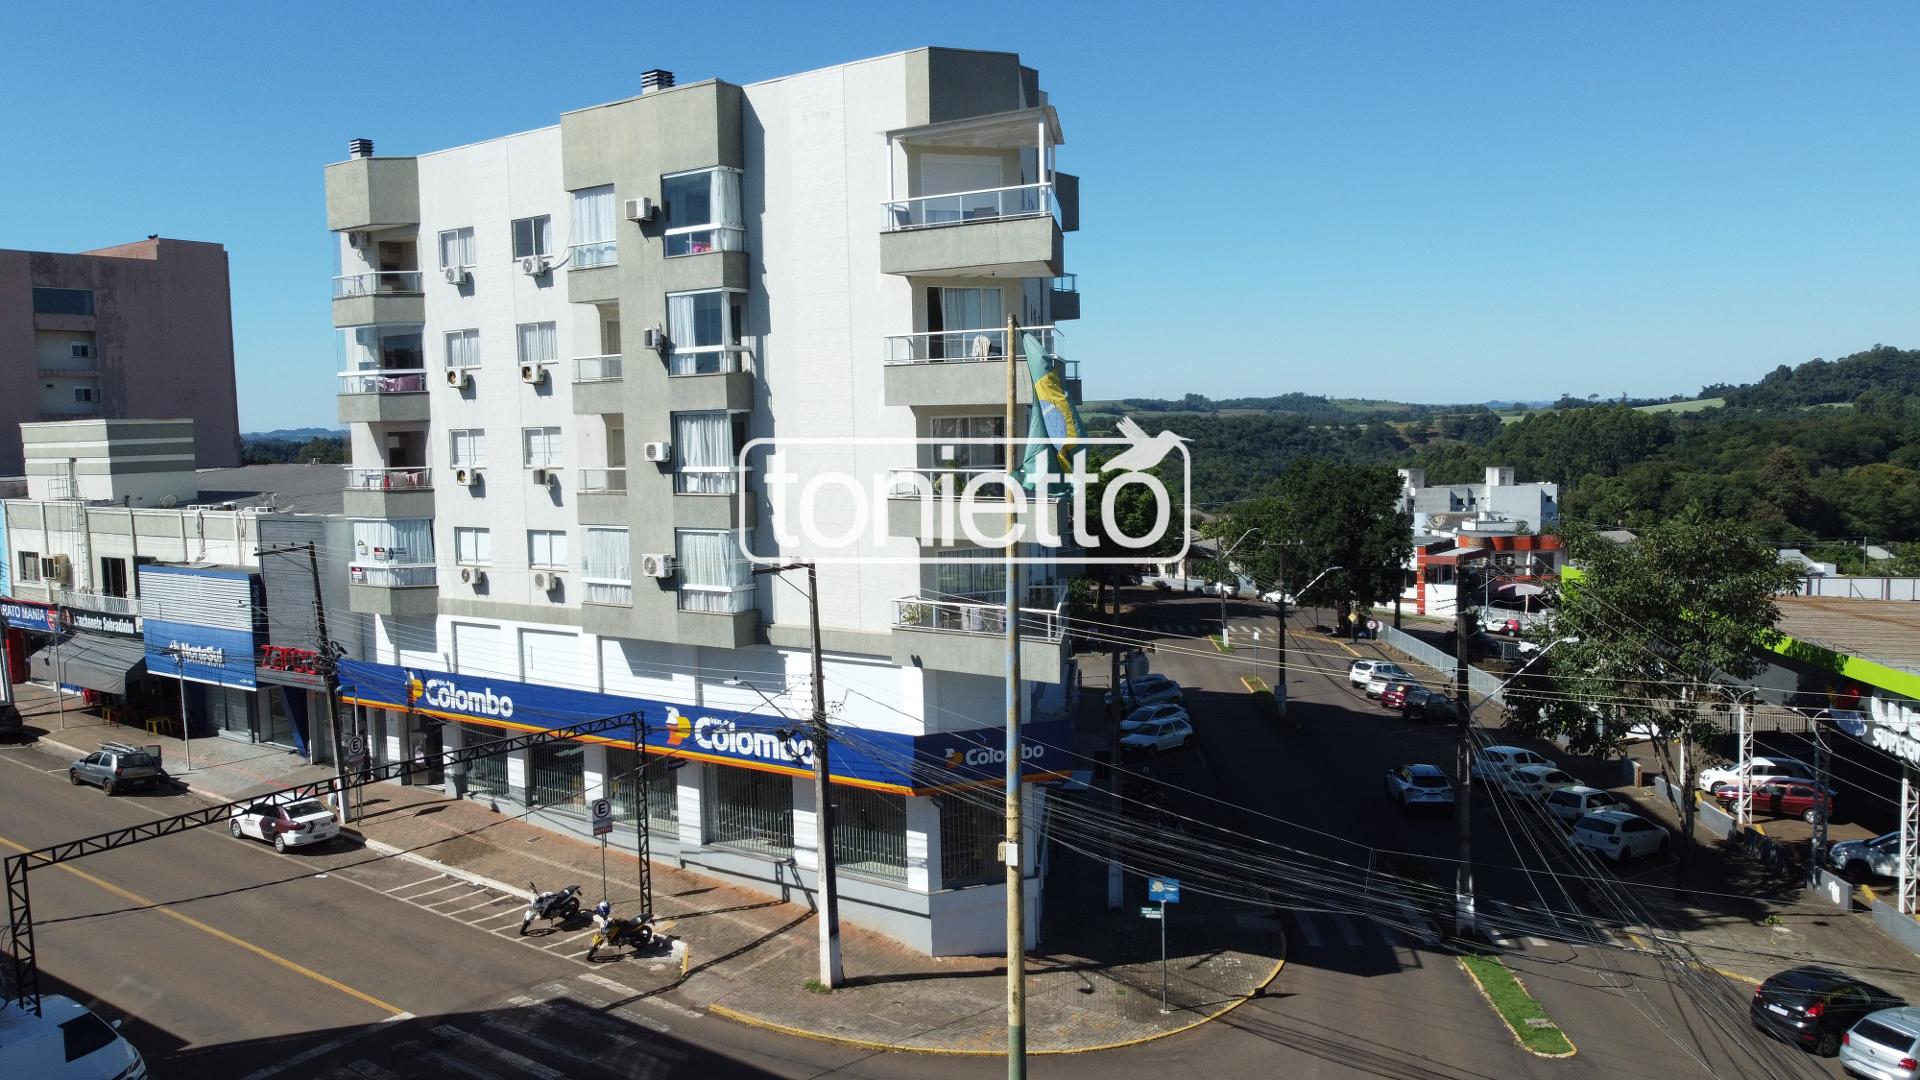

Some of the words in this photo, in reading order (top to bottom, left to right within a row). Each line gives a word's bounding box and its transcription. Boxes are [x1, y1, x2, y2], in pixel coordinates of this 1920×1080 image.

[0, 604, 21, 618] RATO
[22, 607, 46, 622] MANIA
[426, 679, 514, 717] Colombo
[965, 743, 1045, 766] Colobo
